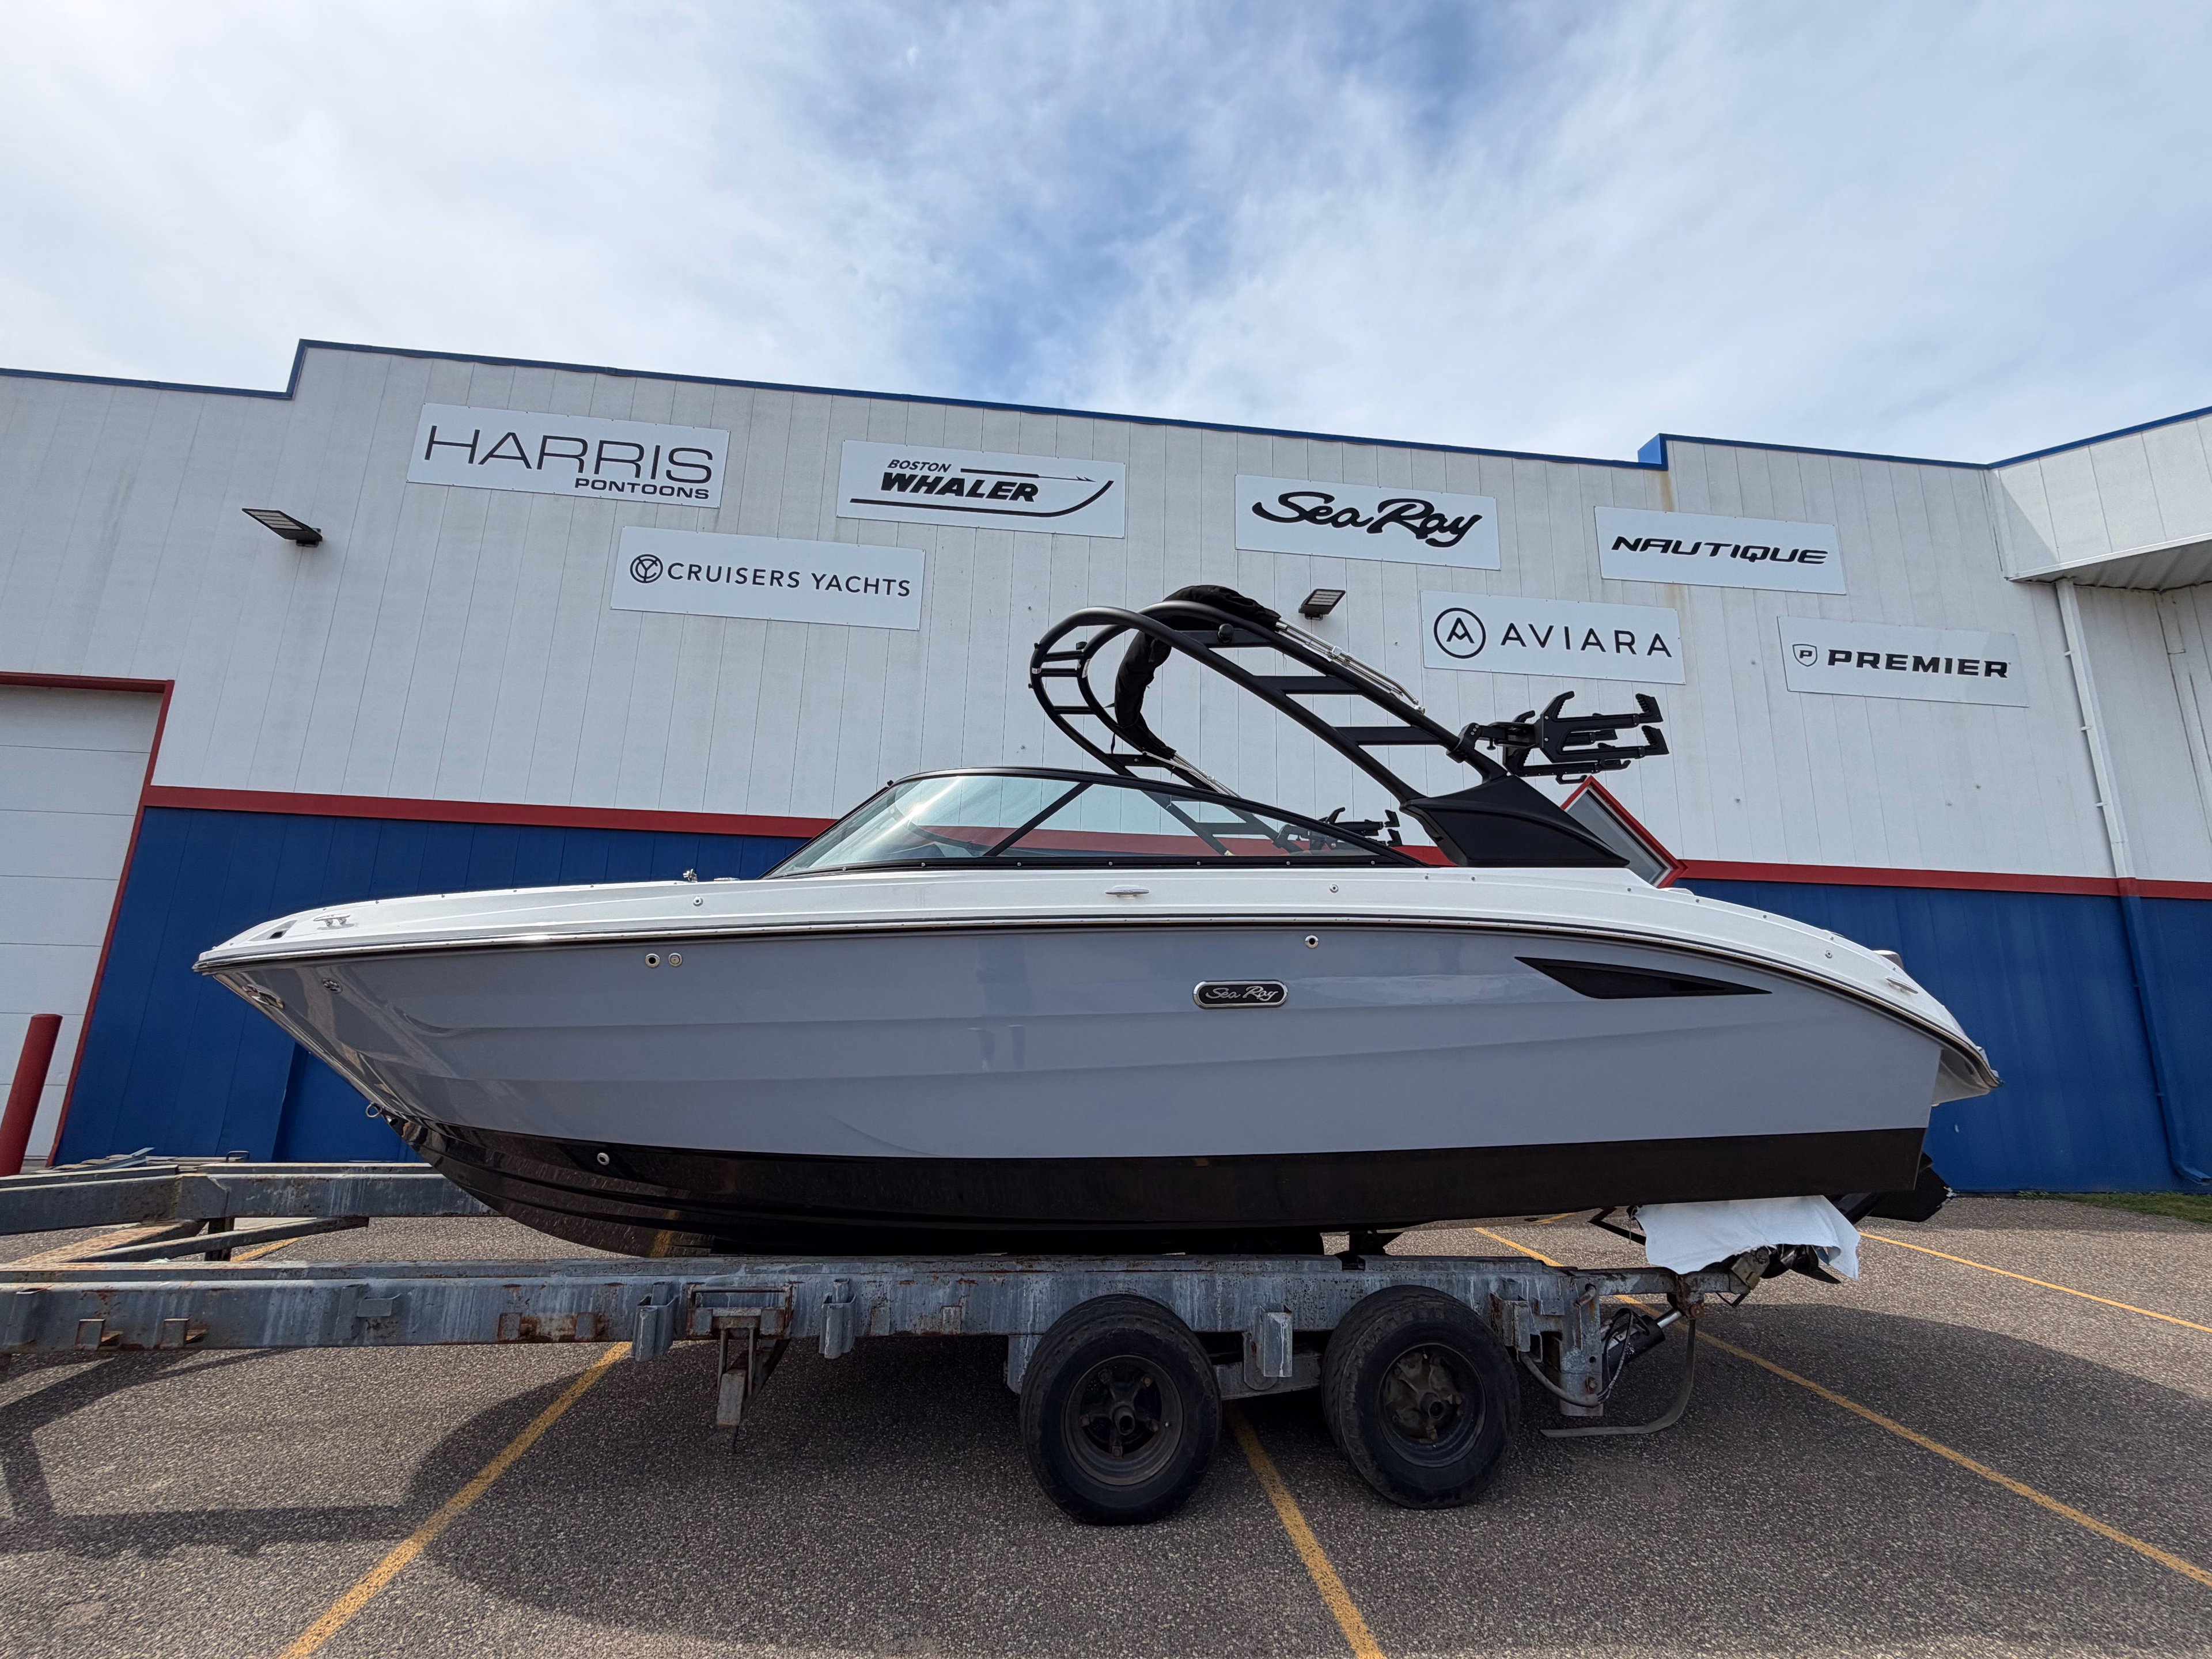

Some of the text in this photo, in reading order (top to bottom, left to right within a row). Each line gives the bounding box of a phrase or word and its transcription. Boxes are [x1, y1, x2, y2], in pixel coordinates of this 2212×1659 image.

[424, 425, 713, 484] HARRIS
[887, 459, 952, 473] BOSTON
[574, 478, 709, 499] PONTOONS
[881, 472, 1039, 502] WHALER
[1252, 491, 1483, 548] Sea Ray
[1611, 536, 1828, 565] NAUTIQUE
[667, 562, 801, 588] CRUISERS
[810, 573, 910, 597] YACHTS
[1500, 622, 1672, 658] AVIARA
[1827, 649, 2008, 679] PREMIER
[1205, 986, 1278, 1001] Sea Ray
